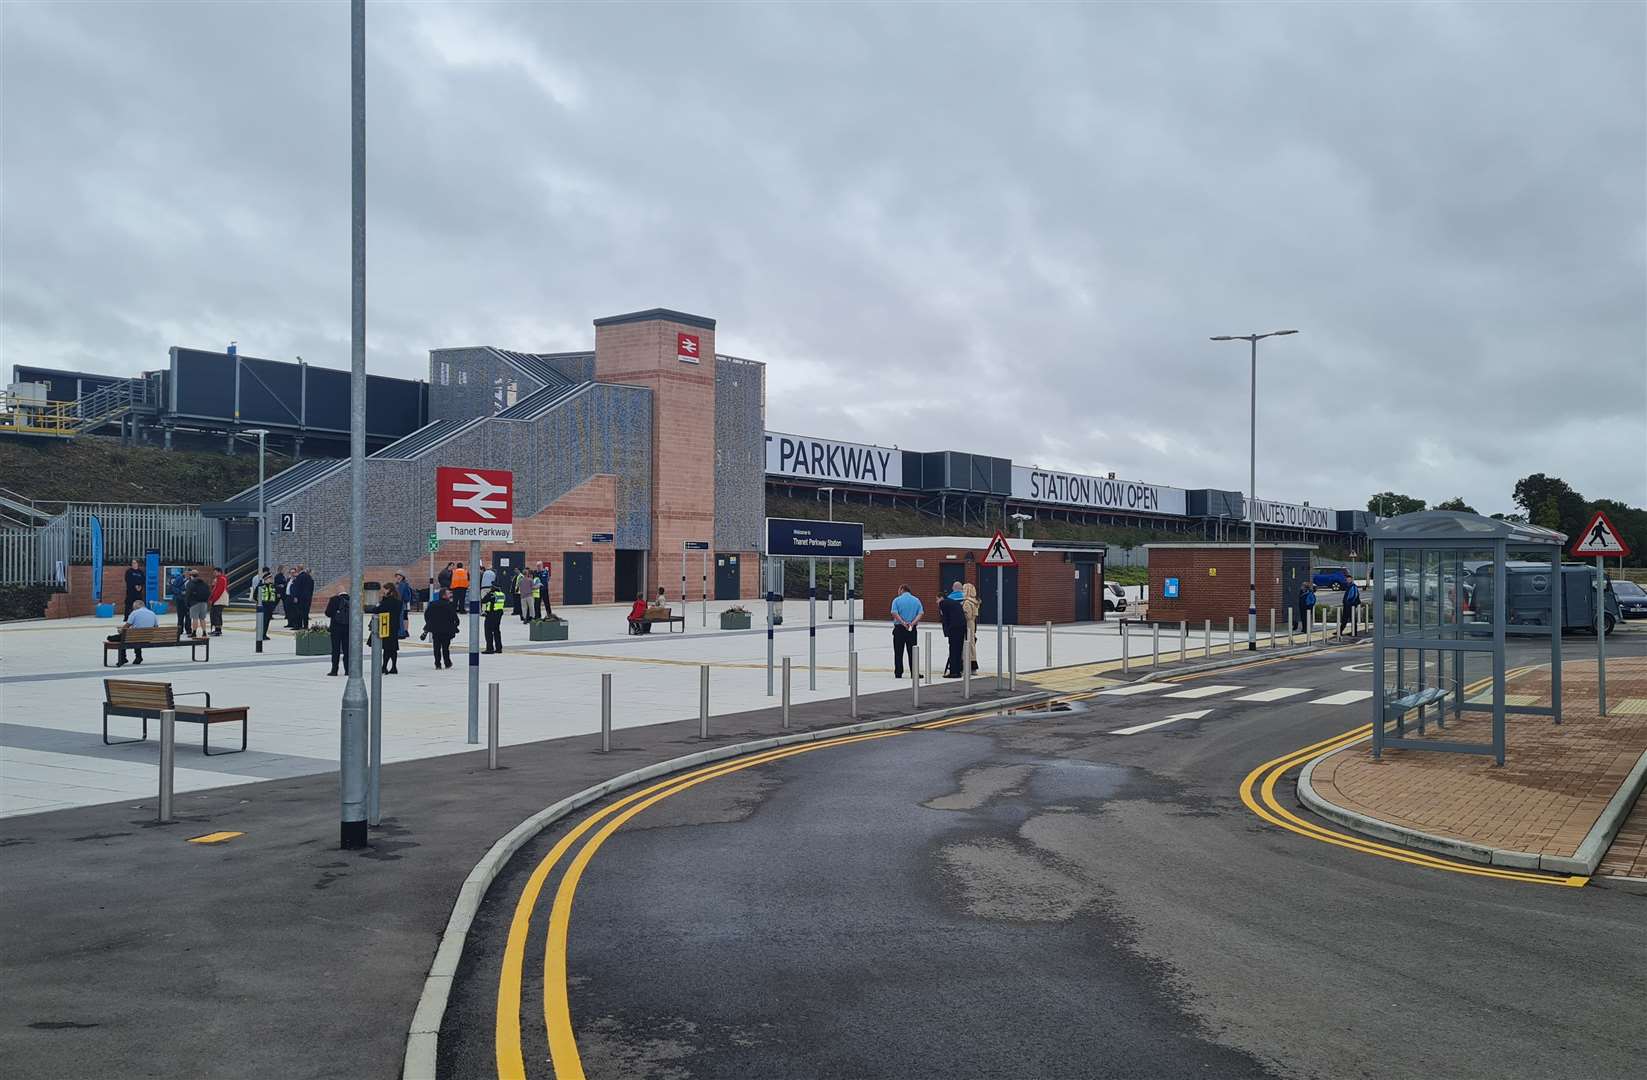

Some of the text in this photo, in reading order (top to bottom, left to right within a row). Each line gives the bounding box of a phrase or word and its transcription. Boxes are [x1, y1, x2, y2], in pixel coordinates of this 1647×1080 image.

[780, 438, 890, 482] PARKWAY
[1031, 472, 1158, 511] STATION NOW OPEN
[284, 515, 291, 530] 2
[1286, 506, 1296, 525] TO
[1297, 508, 1328, 529] LONDON
[450, 526, 510, 538] Thanet Parkway
[793, 537, 842, 548] Thanet Parkway Station
